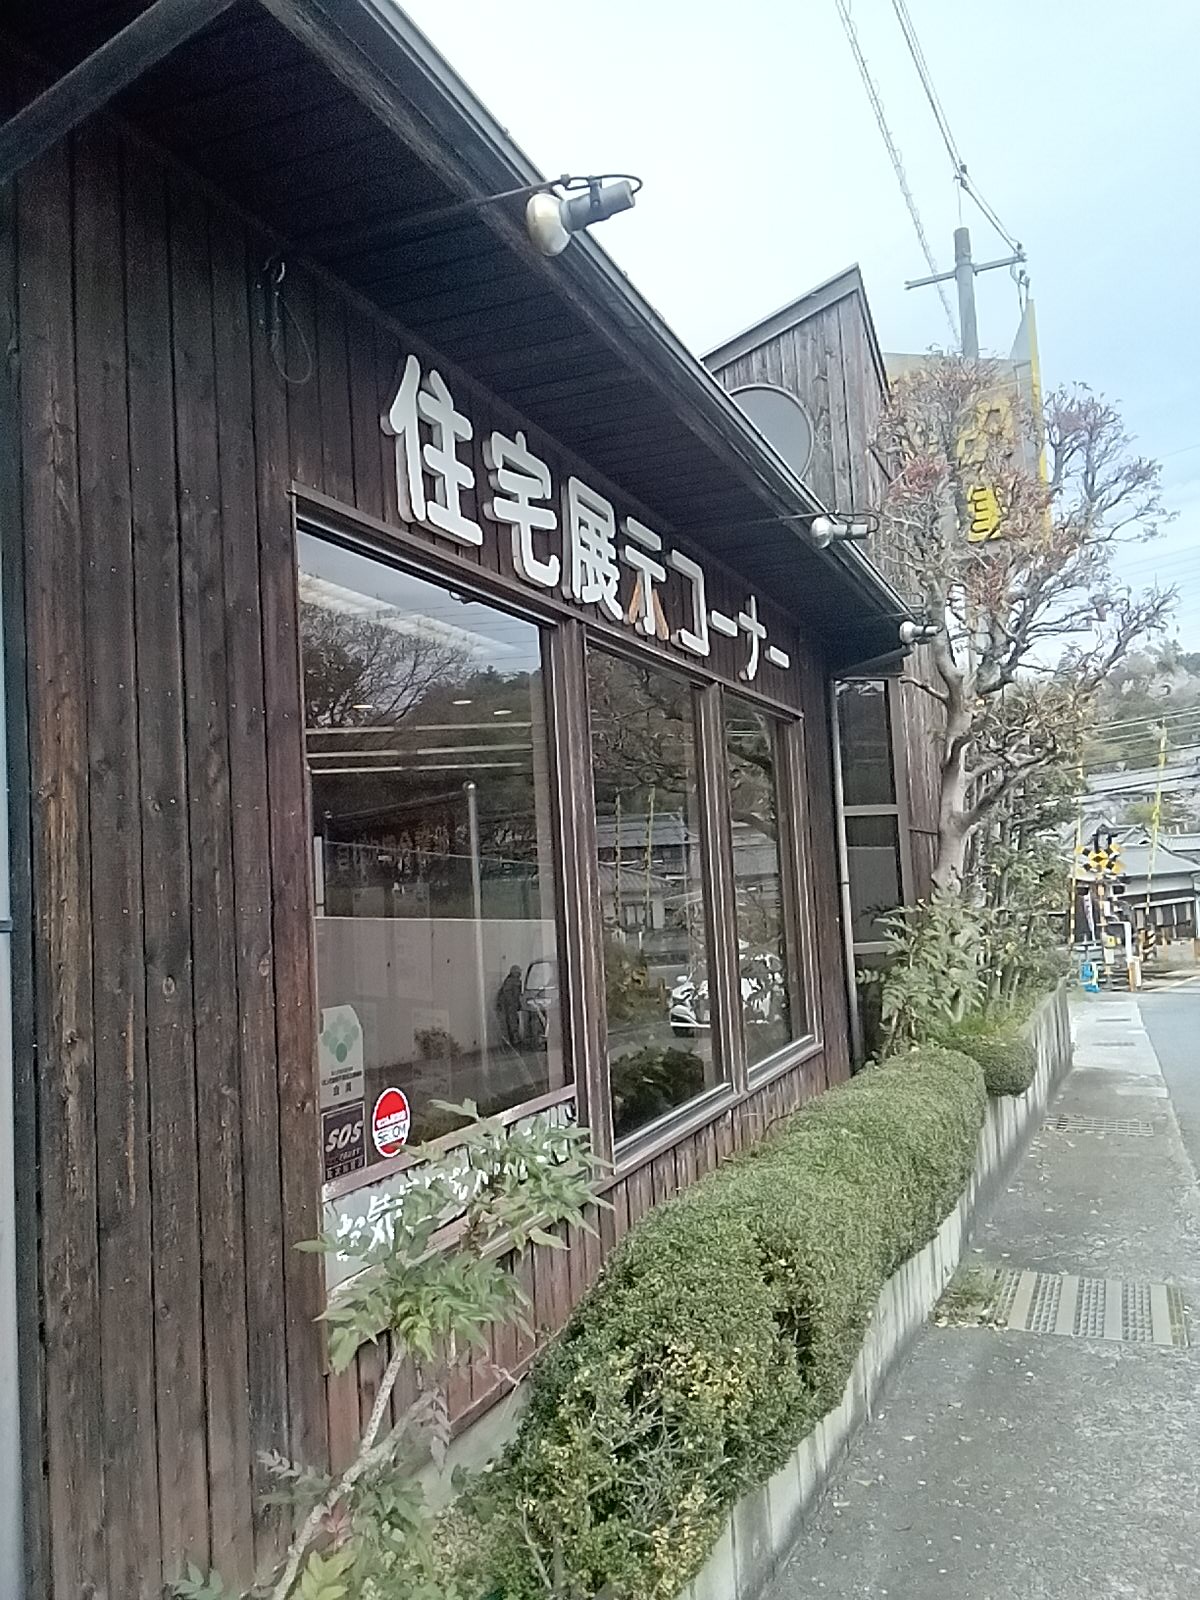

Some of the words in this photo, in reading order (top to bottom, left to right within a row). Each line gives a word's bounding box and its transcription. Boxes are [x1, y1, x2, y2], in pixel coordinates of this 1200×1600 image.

[381, 354, 789, 681] 住宅展示コーナー
[325, 1120, 364, 1153] SOS
